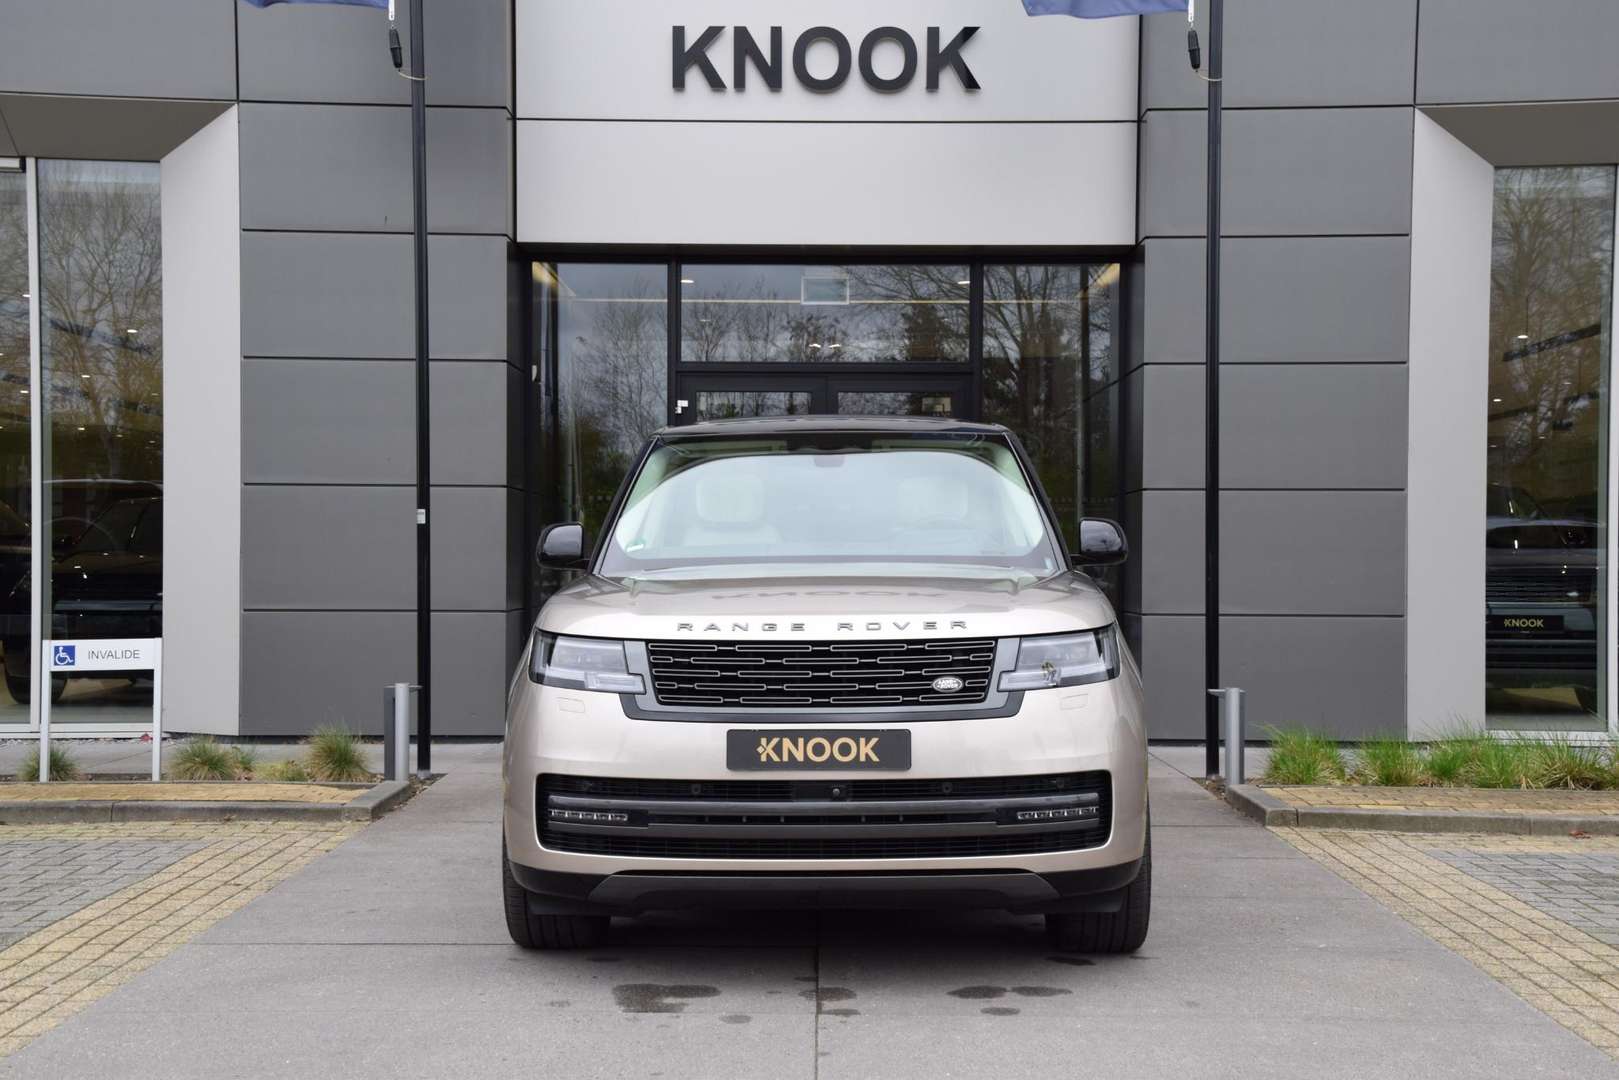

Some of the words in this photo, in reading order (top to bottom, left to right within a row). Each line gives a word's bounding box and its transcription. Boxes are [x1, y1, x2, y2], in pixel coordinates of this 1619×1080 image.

[672, 25, 981, 92] KNOOK
[677, 622, 806, 632] RANGE
[837, 621, 967, 631] ROVER
[1504, 618, 1544, 628] KNOOK
[88, 649, 140, 660] INVALIDE
[757, 736, 880, 762] KNOOK
